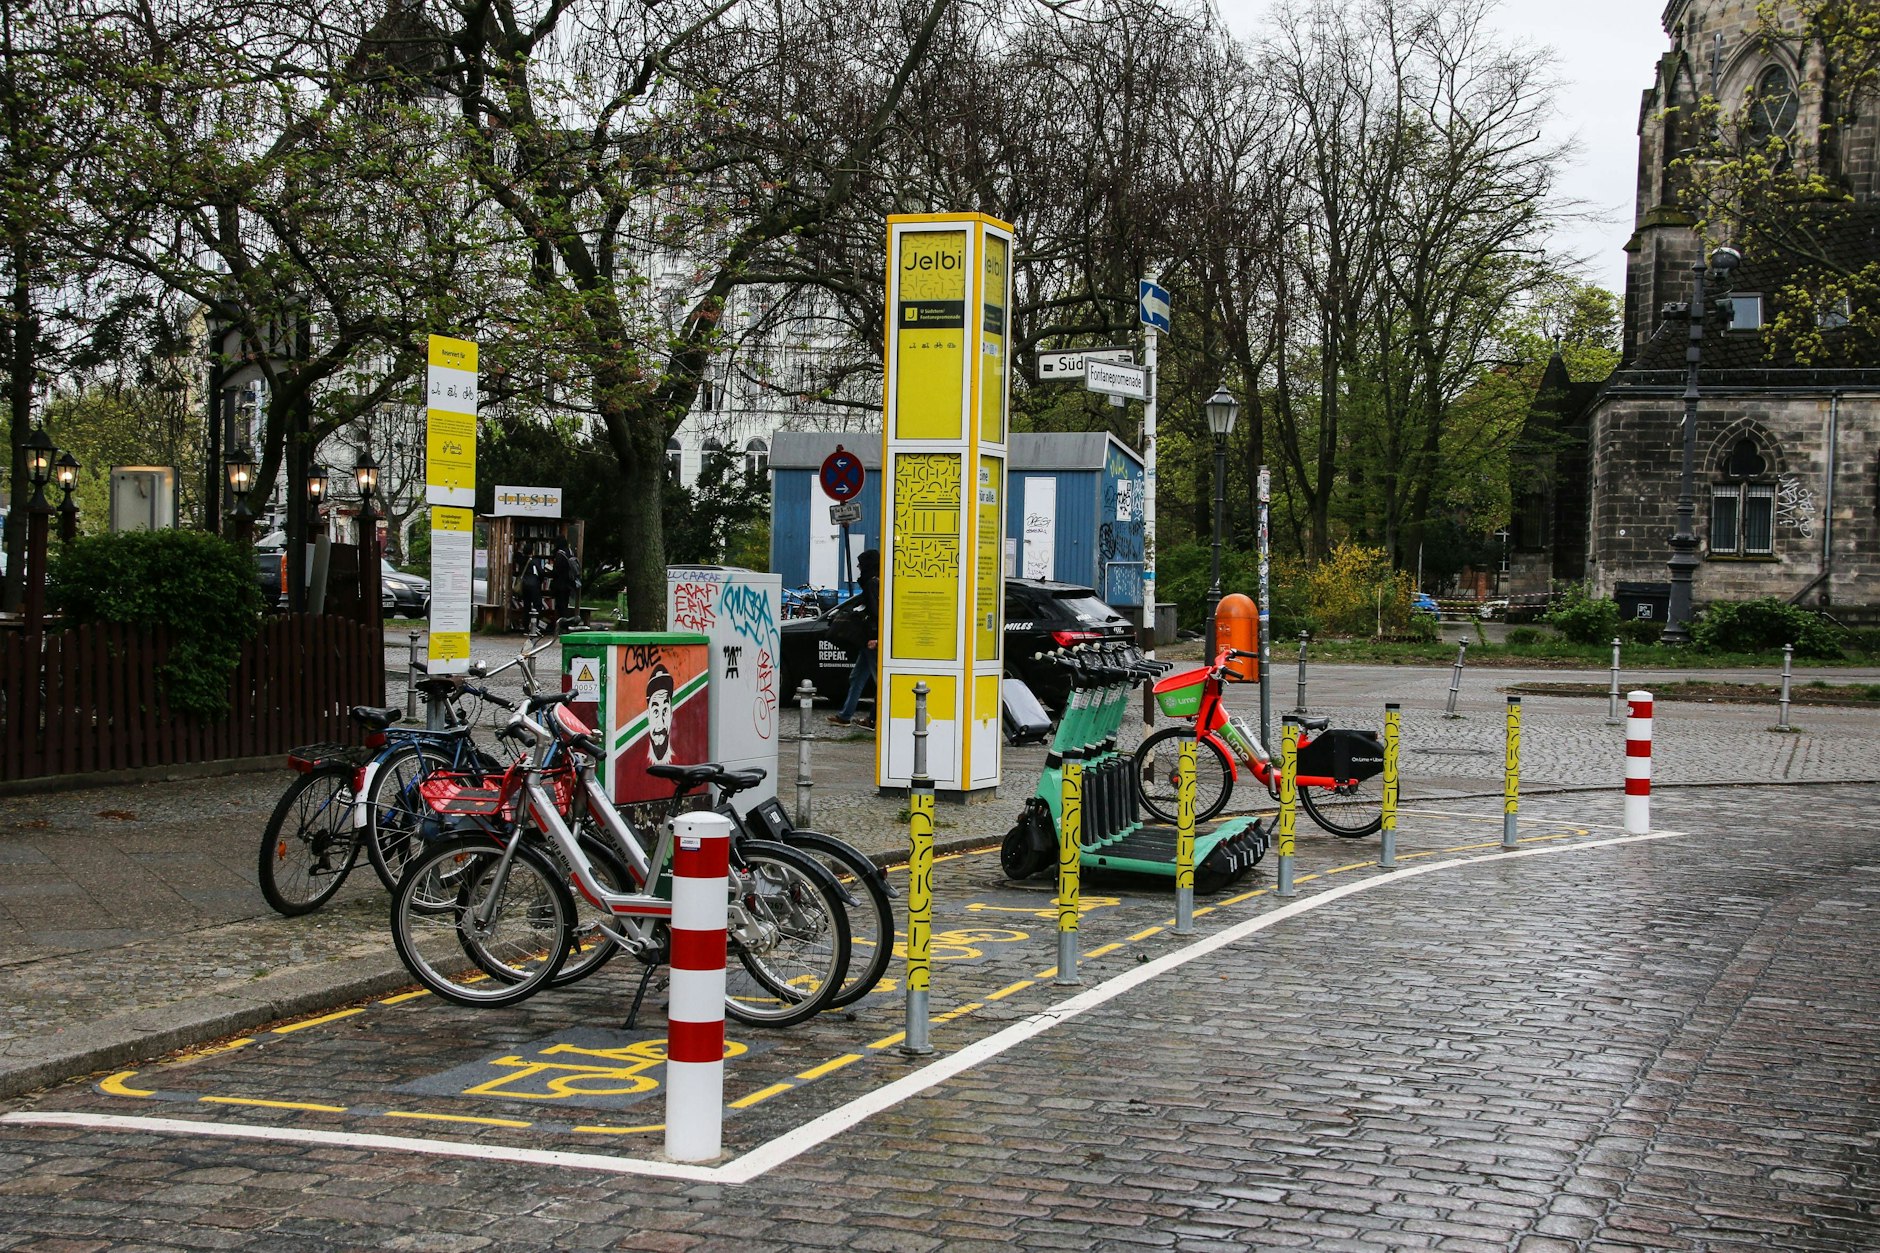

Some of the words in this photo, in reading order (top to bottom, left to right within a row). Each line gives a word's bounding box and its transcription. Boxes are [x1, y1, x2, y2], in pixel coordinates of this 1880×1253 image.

[904, 250, 963, 271] Jelbi
[1090, 365, 1142, 388] Fontanepromenade
[504, 492, 553, 507] LESE
[675, 595, 716, 619] ERIK
[1004, 622, 1034, 631] MILES
[818, 650, 848, 661] REPEAT.
[1177, 696, 1198, 705] Lime
[1226, 732, 1250, 762] Lime
[547, 835, 558, 852] Call
[560, 855, 572, 872] Bike
[604, 828, 615, 845] Call
[617, 846, 629, 864] Bike
